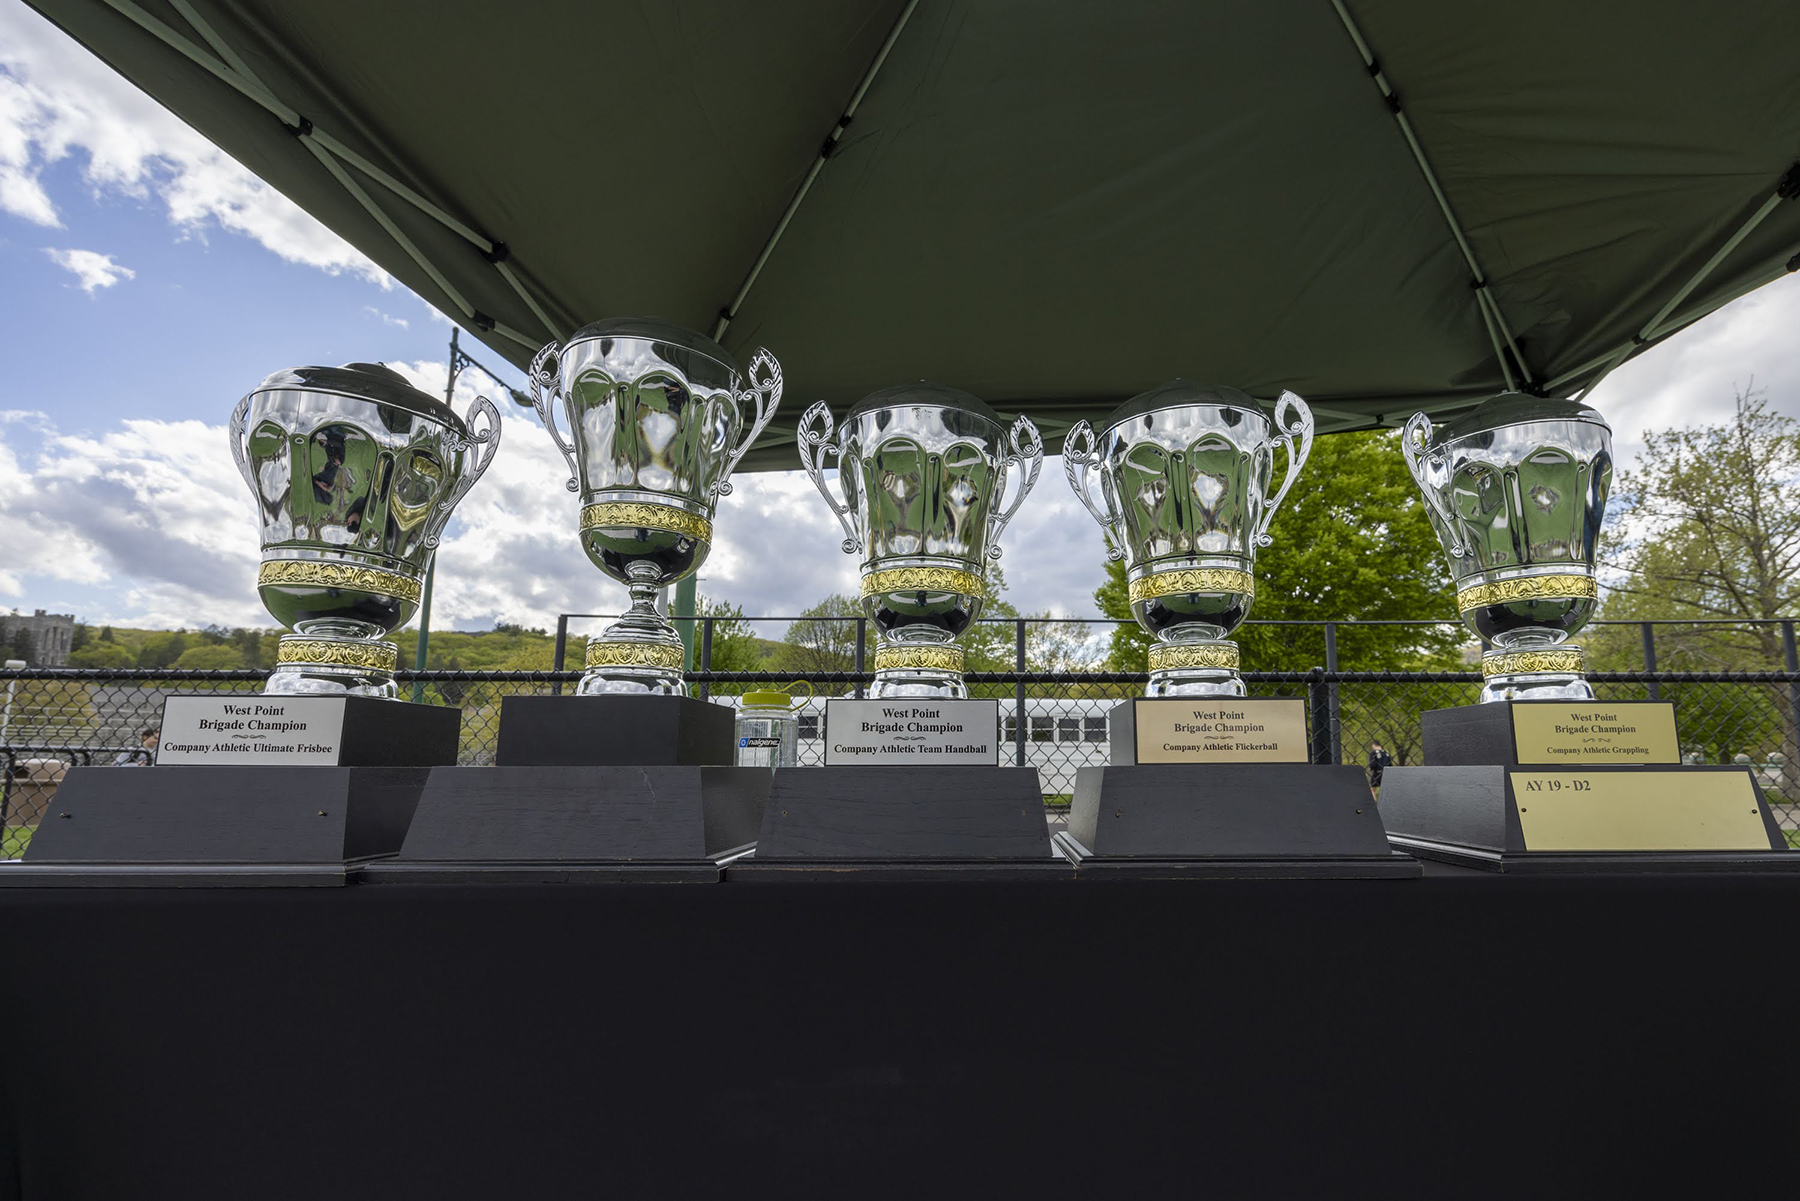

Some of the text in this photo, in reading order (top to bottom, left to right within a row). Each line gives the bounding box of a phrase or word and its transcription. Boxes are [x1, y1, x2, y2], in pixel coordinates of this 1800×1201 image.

[224, 705, 284, 715] West Point
[882, 709, 940, 718] West Point
[1193, 711, 1244, 719] West Point
[199, 719, 306, 733] Brigade Champion
[862, 722, 963, 734] Brigade Champion
[1175, 723, 1264, 734] Brigade Champion
[1555, 725, 1636, 735] Brigade Champion
[165, 742, 332, 753] Company Athletic Ultimate Frisbee
[749, 739, 778, 747] nalgene
[1163, 742, 1277, 753] Company Athletic Flickerball
[834, 745, 986, 755] Company Athletic Team Handball
[1547, 746, 1649, 756] Company Athletic Grappling
[1525, 780, 1543, 791] AY
[1548, 780, 1561, 791] 19
[1573, 780, 1591, 791] D2
